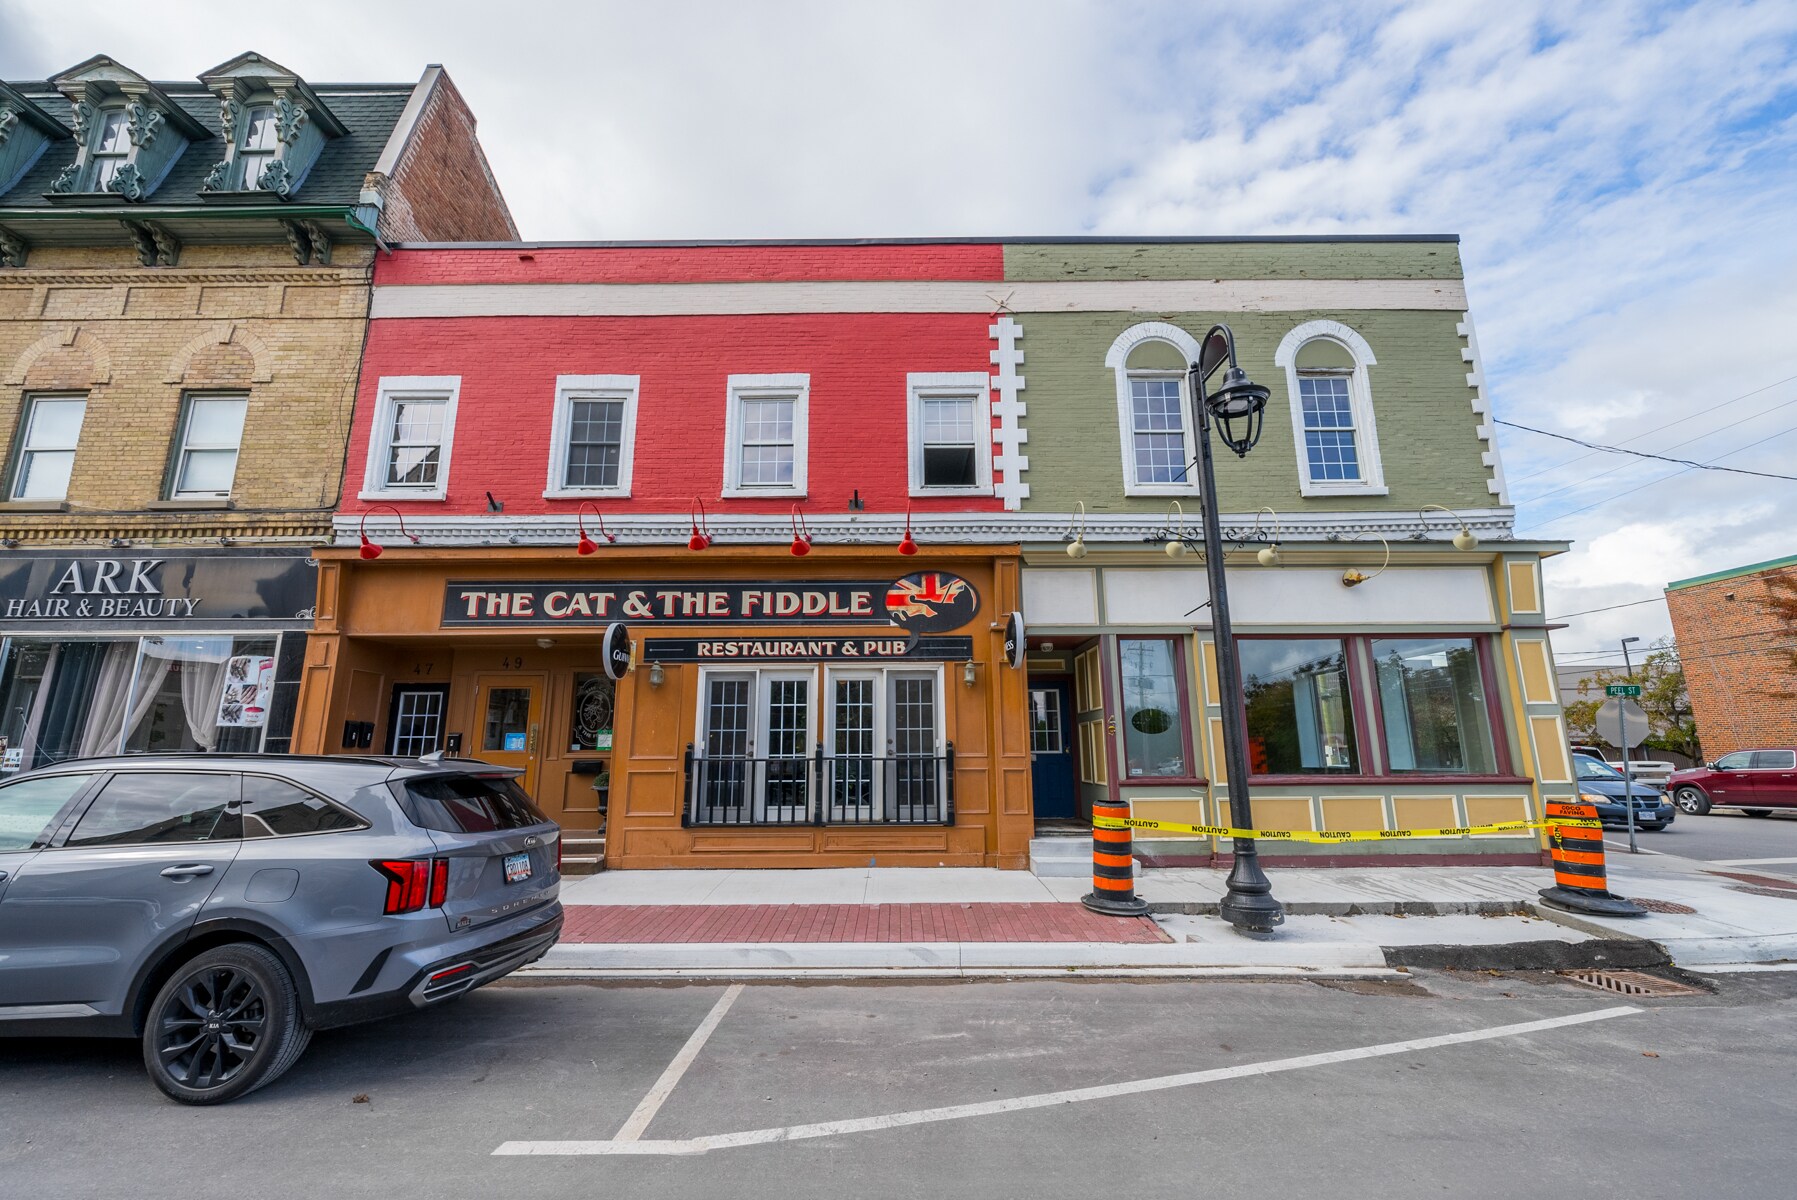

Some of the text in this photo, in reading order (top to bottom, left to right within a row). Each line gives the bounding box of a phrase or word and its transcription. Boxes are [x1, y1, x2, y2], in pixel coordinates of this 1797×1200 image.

[50, 559, 165, 594] ARK
[4, 598, 203, 618] HAIR & BEAUTY
[460, 590, 875, 619] THE CAT & THE FIDDLE
[697, 641, 906, 656] RESTAURANT & PUB
[502, 656, 523, 669] 49
[413, 663, 434, 675] 47
[1610, 686, 1636, 695] PEEL ST
[1123, 819, 1159, 828] CAUTION
[1191, 825, 1229, 835] CAUTION
[1260, 830, 1291, 838] CAUTION
[1439, 827, 1471, 835] CAUTION
